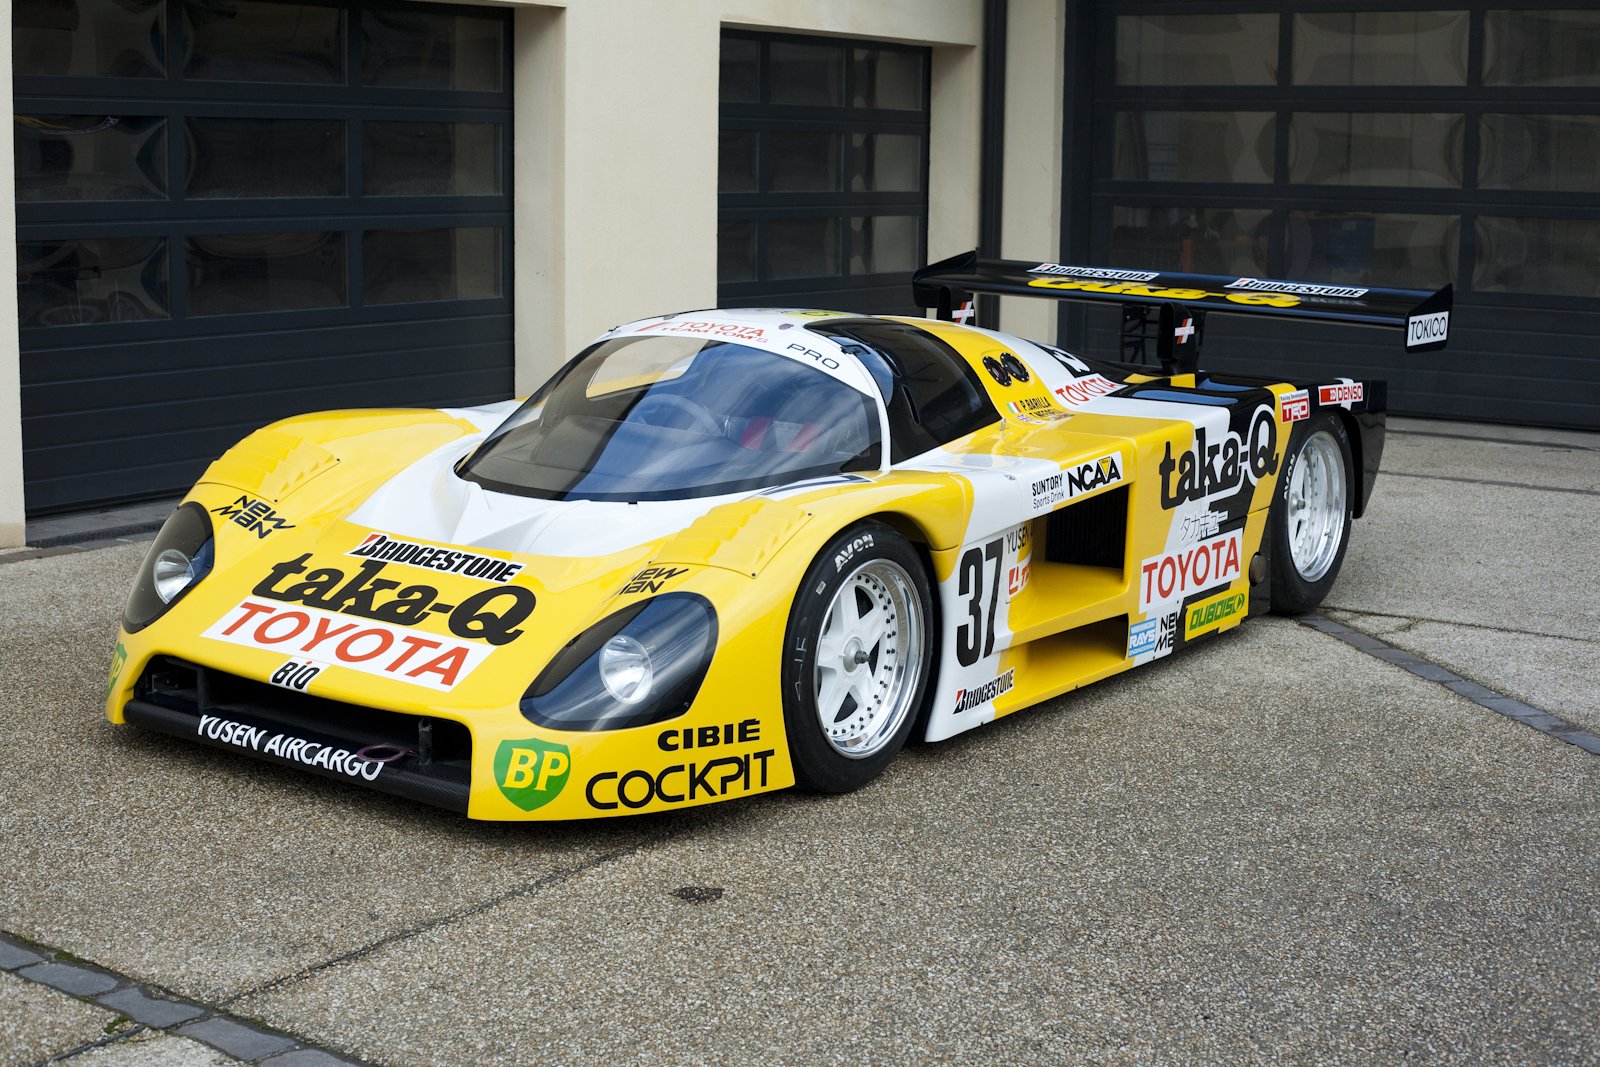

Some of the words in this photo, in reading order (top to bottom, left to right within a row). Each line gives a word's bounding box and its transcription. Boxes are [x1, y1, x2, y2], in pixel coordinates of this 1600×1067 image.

[1036, 263, 1156, 281] BRIDGESTONE
[1235, 278, 1366, 297] BRIDGESTONE
[679, 321, 764, 337] TOYOTA
[1409, 315, 1447, 341] TOKICO
[786, 343, 840, 370] PRO
[1055, 377, 1116, 406] TOYOTA
[1282, 401, 1309, 421] TRD
[1337, 386, 1362, 401] DENSO
[1031, 473, 1063, 497] SUNTORY
[1067, 455, 1122, 497] NCAA
[1159, 409, 1279, 511] taka-Q
[1032, 494, 1050, 511] Sports
[1051, 488, 1065, 503] Drink
[352, 533, 523, 583] BRIDGESTONE
[834, 533, 875, 574] AVON
[1142, 536, 1240, 605] TOYOTA
[251, 552, 537, 646] taka-Q
[956, 537, 1004, 668] 37
[222, 601, 470, 687] TOYOTA
[1129, 628, 1156, 650] RAYS
[953, 668, 1014, 715] BRIDGESTONE
[198, 714, 267, 751] YUSEN
[264, 733, 385, 782] AIRCARGO
[502, 747, 569, 792] BP
[585, 748, 775, 810] COCKPIT
